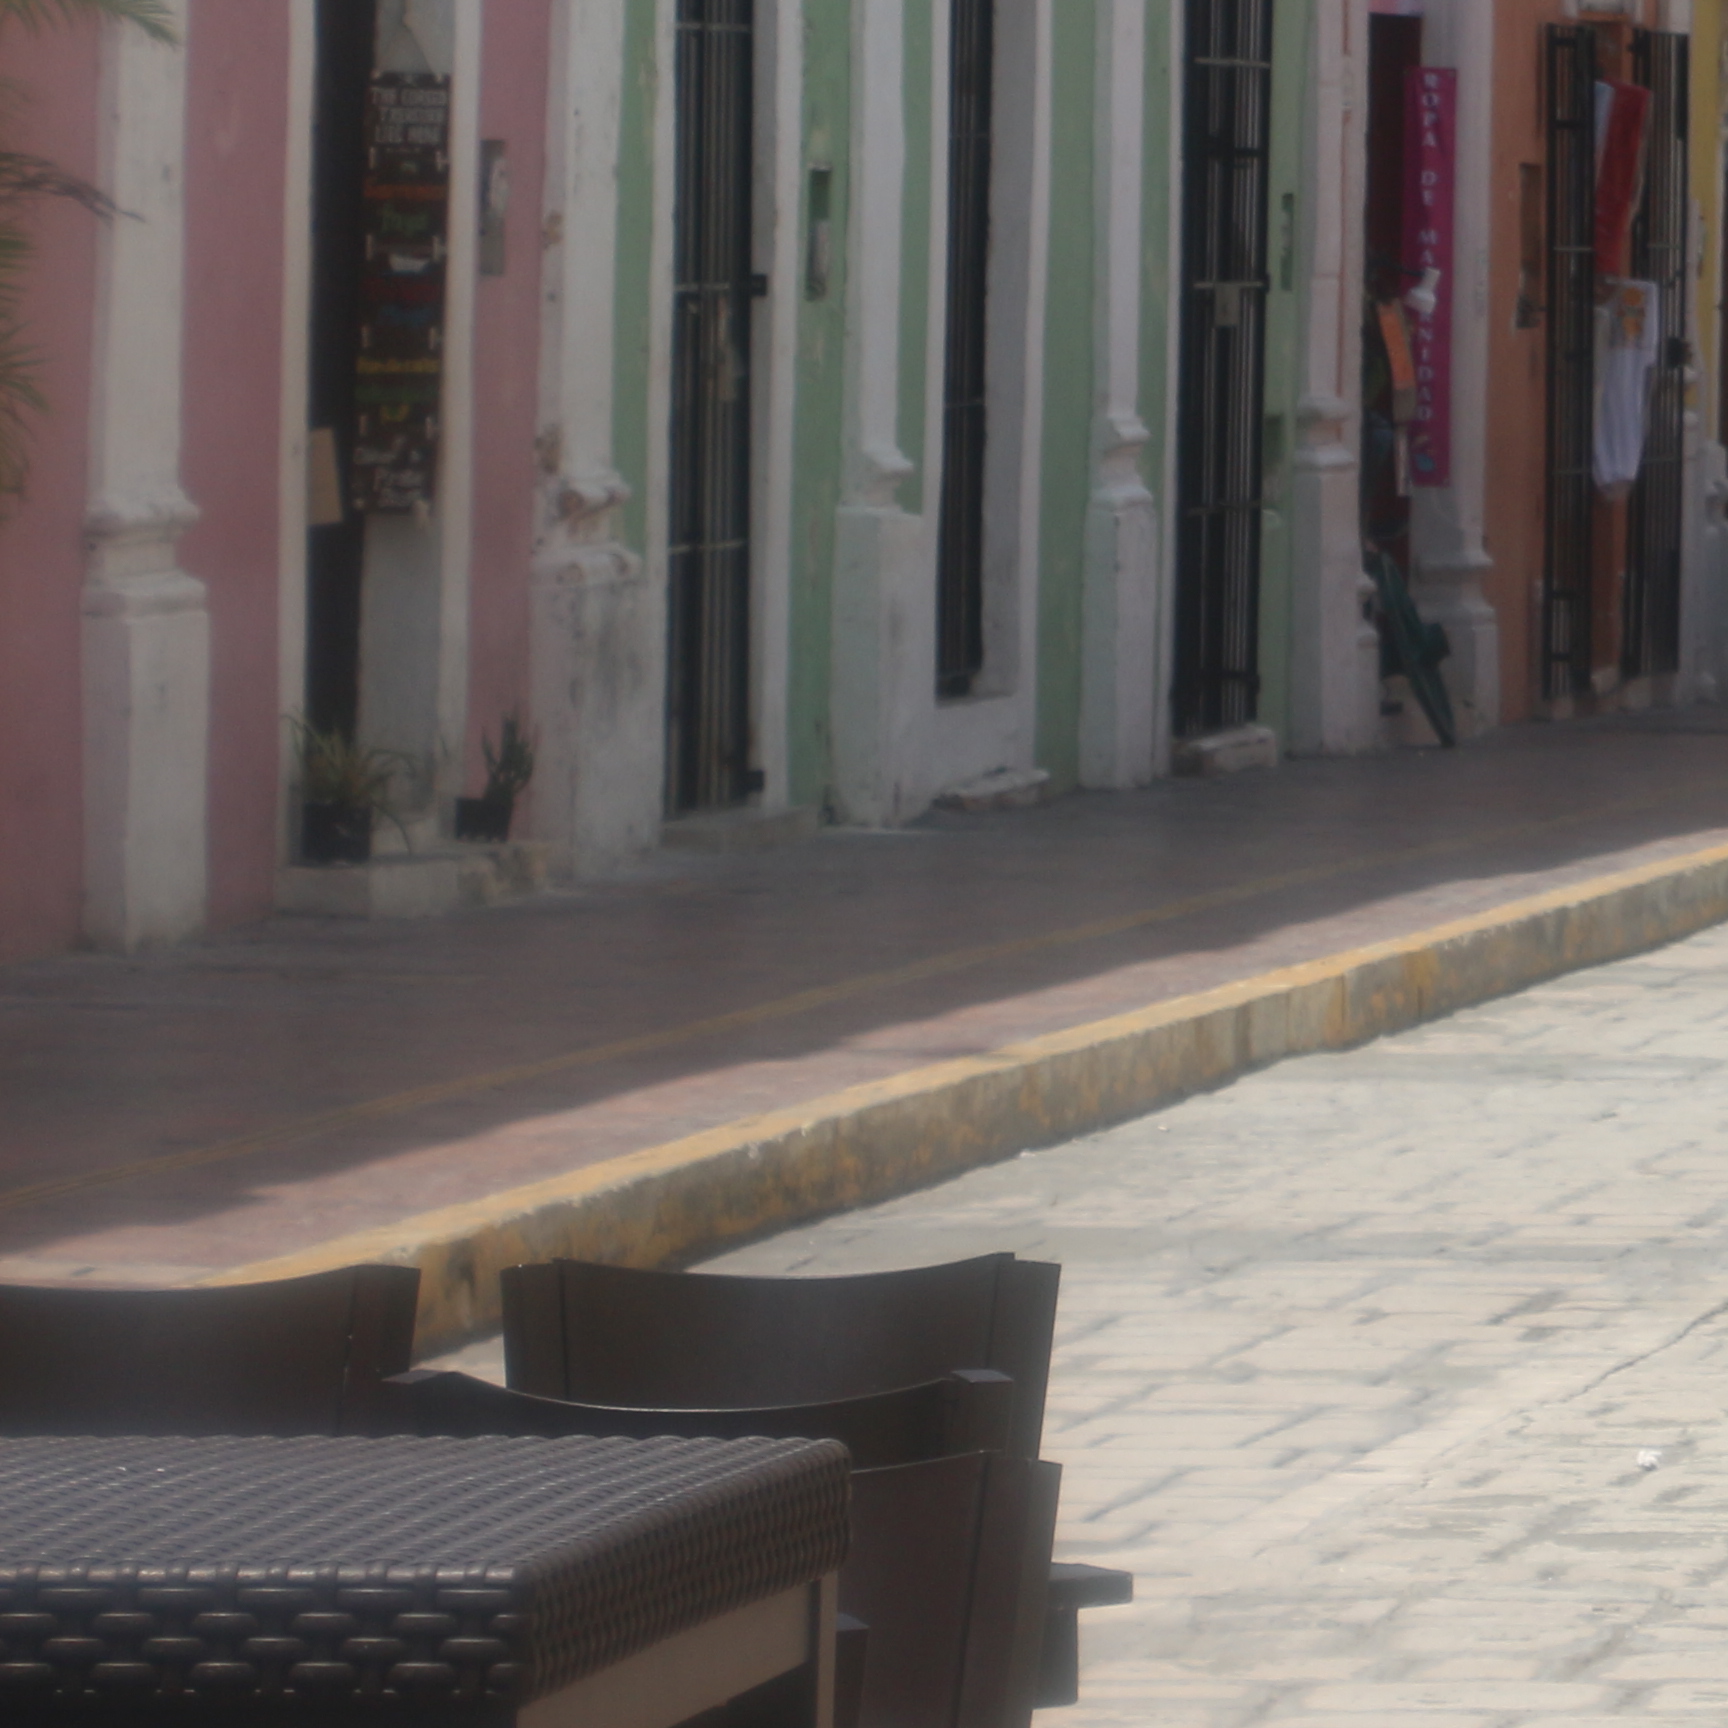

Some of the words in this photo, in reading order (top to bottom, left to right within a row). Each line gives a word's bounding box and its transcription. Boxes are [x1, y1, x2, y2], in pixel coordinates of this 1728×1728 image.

[1422, 72, 1440, 148] ROPA
[1419, 170, 1439, 207] DE
[1415, 228, 1438, 422] MARNIDAD
